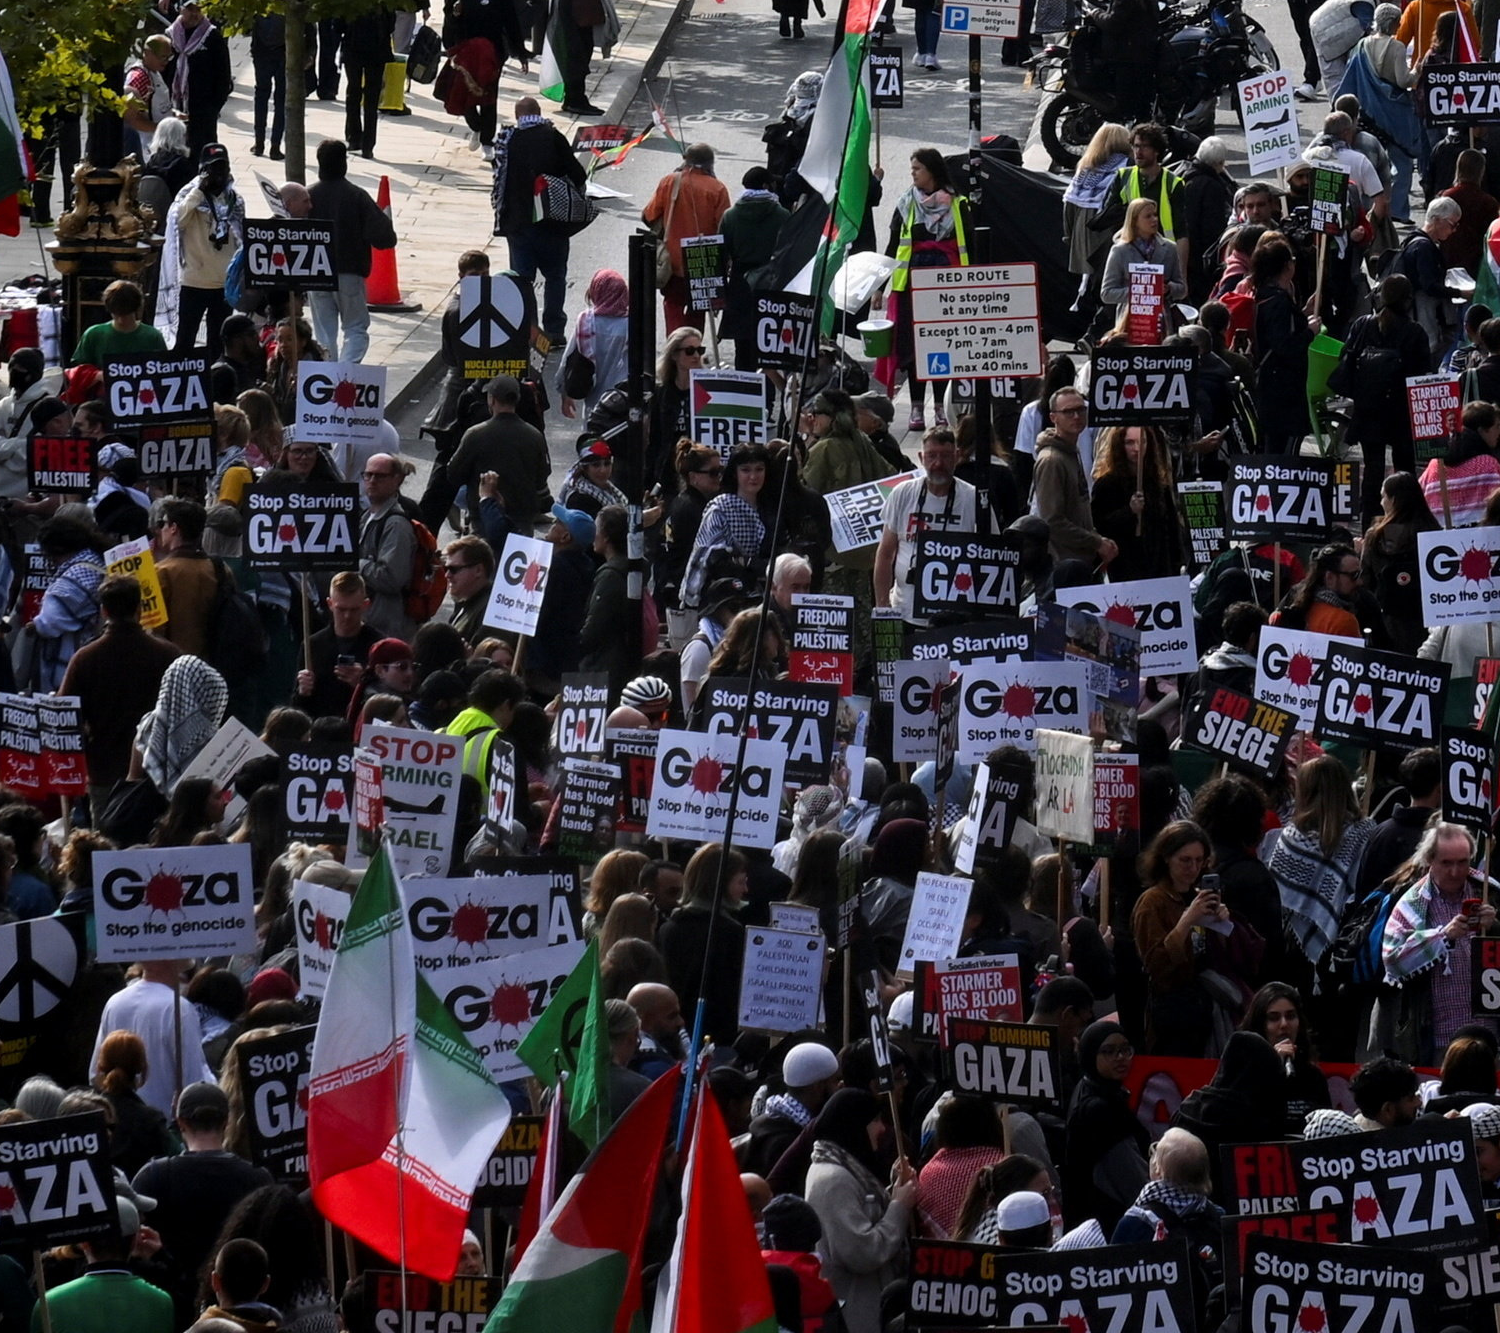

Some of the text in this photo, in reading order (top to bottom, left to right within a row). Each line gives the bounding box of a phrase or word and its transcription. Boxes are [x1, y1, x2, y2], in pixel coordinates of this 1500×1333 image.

[971, 17, 1015, 25] motorcycles
[937, 271, 1010, 282] RED ROUTE
[940, 292, 1010, 303] No stopping
[943, 304, 1007, 316] at any time
[919, 324, 1034, 337] Except 10 am 4 pm
[946, 338, 1007, 349] 7 pm 7 am
[969, 350, 1013, 359] Loading
[108, 357, 205, 378] Stop Starving
[464, 359, 527, 371] NUCLEAR-FREE
[982, 362, 998, 371] 40
[1002, 361, 1028, 371] mins
[110, 375, 207, 419] GAZA
[798, 609, 847, 627] FREEDOM
[794, 632, 849, 651] PALESTINE
[756, 964, 808, 977] CHILDREN IN
